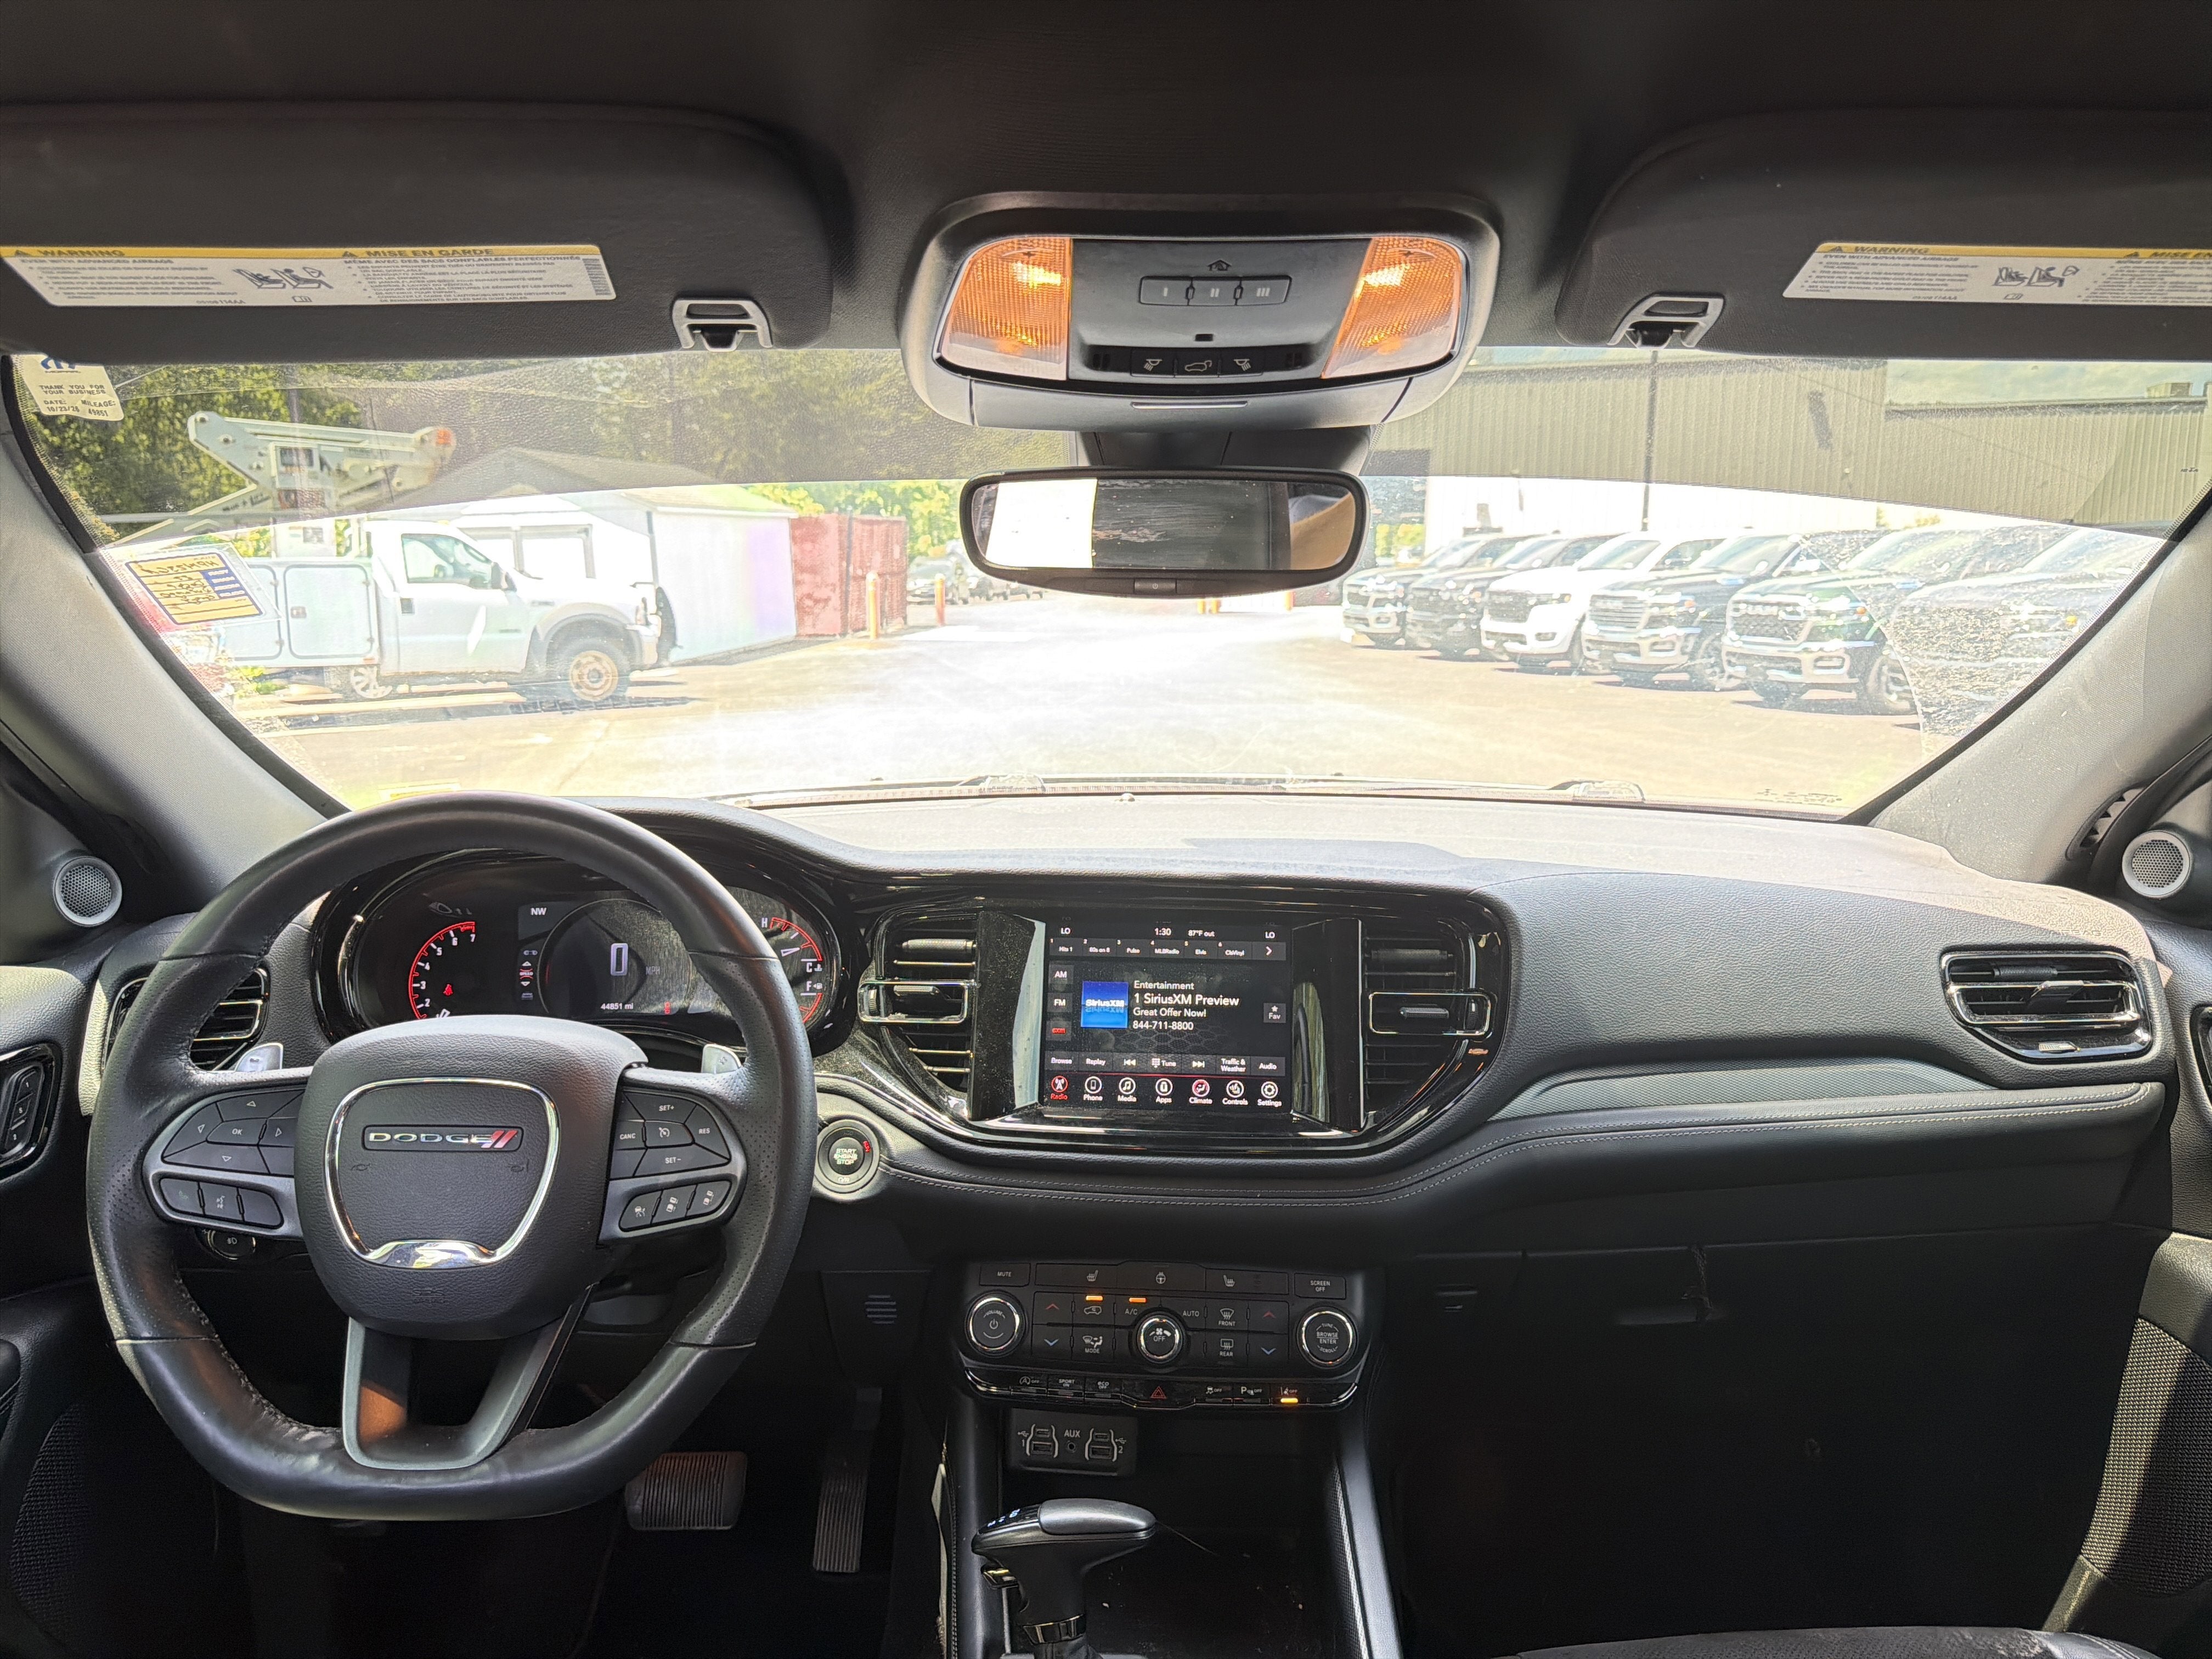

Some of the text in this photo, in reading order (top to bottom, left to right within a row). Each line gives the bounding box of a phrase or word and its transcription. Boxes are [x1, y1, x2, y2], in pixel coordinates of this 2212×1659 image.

[531, 907, 546, 916] NW
[761, 918, 768, 928] H
[1155, 928, 1172, 936] 1:30
[470, 934, 476, 942] 7
[437, 947, 442, 956] 5
[611, 943, 628, 975] 0
[646, 966, 661, 975] MPH
[806, 963, 812, 973] C
[806, 981, 812, 991] F
[1134, 980, 1194, 990] Entertainment
[1134, 993, 1239, 1006] 1 SiriusXM Preview
[1133, 1008, 1207, 1017] Great Offer Now!
[1132, 1021, 1194, 1030] 844-711-8800
[1257, 1099, 1282, 1107] Settings
[369, 1132, 493, 1144] DODGE
[1064, 1430, 1081, 1438] AUX
